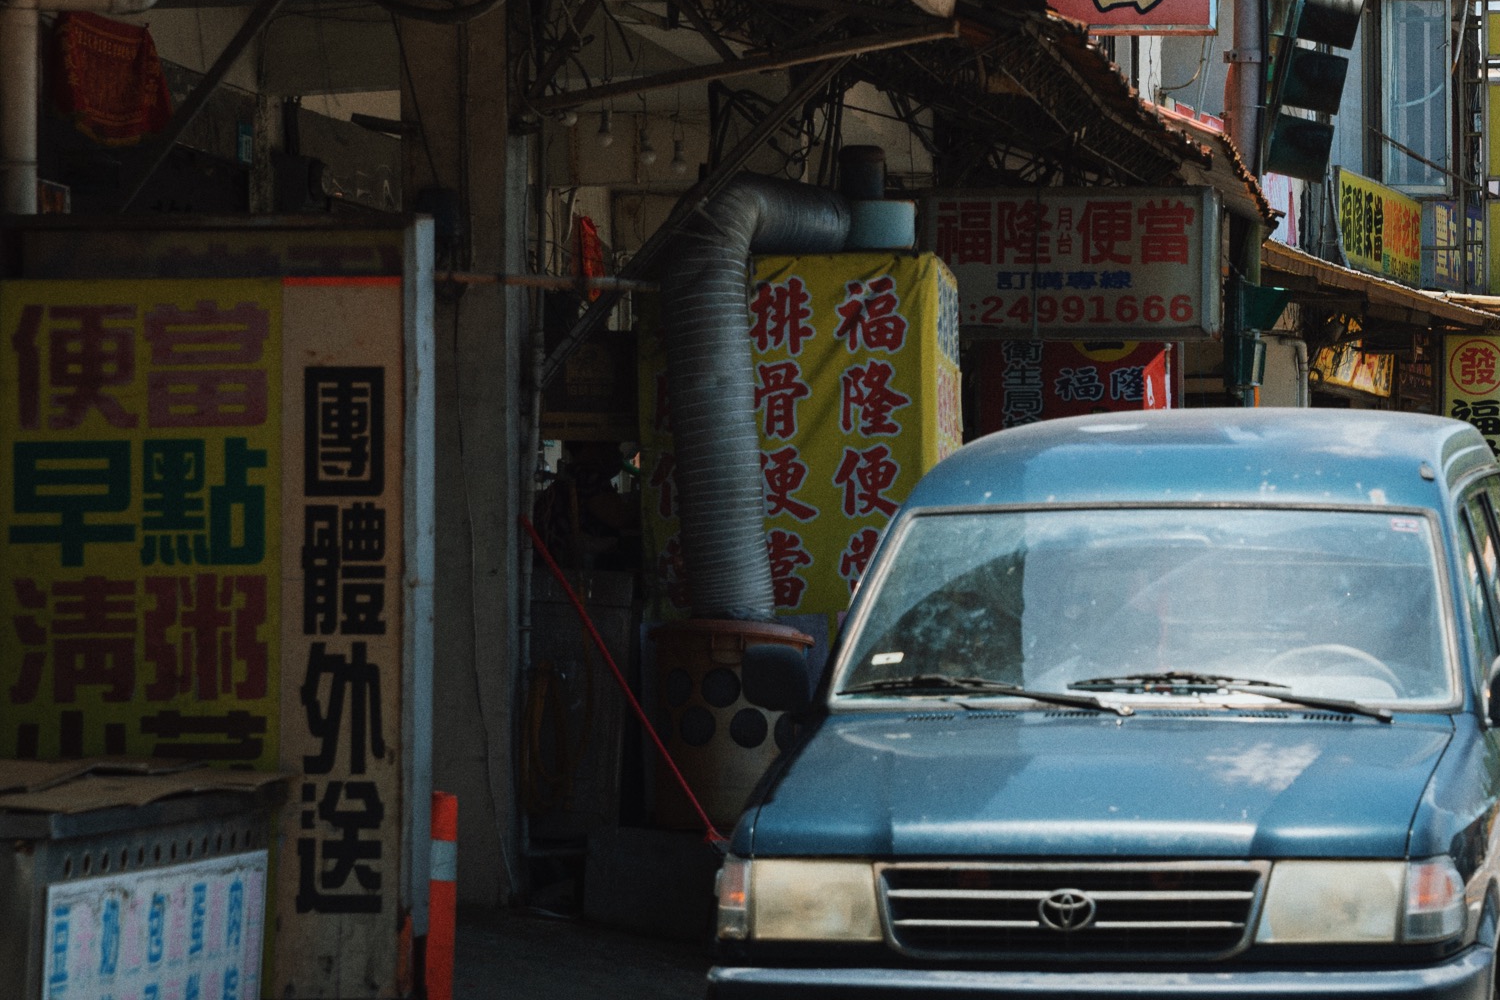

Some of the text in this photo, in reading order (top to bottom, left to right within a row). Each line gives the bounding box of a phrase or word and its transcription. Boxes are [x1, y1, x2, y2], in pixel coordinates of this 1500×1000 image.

[1057, 207, 1073, 255] 月台
[11, 301, 270, 430] 便當
[959, 295, 1194, 325] :24991666
[1459, 347, 1498, 386] 發
[9, 437, 269, 567] 早點
[10, 573, 268, 704] 清粥
[297, 366, 387, 914] 團體外送
